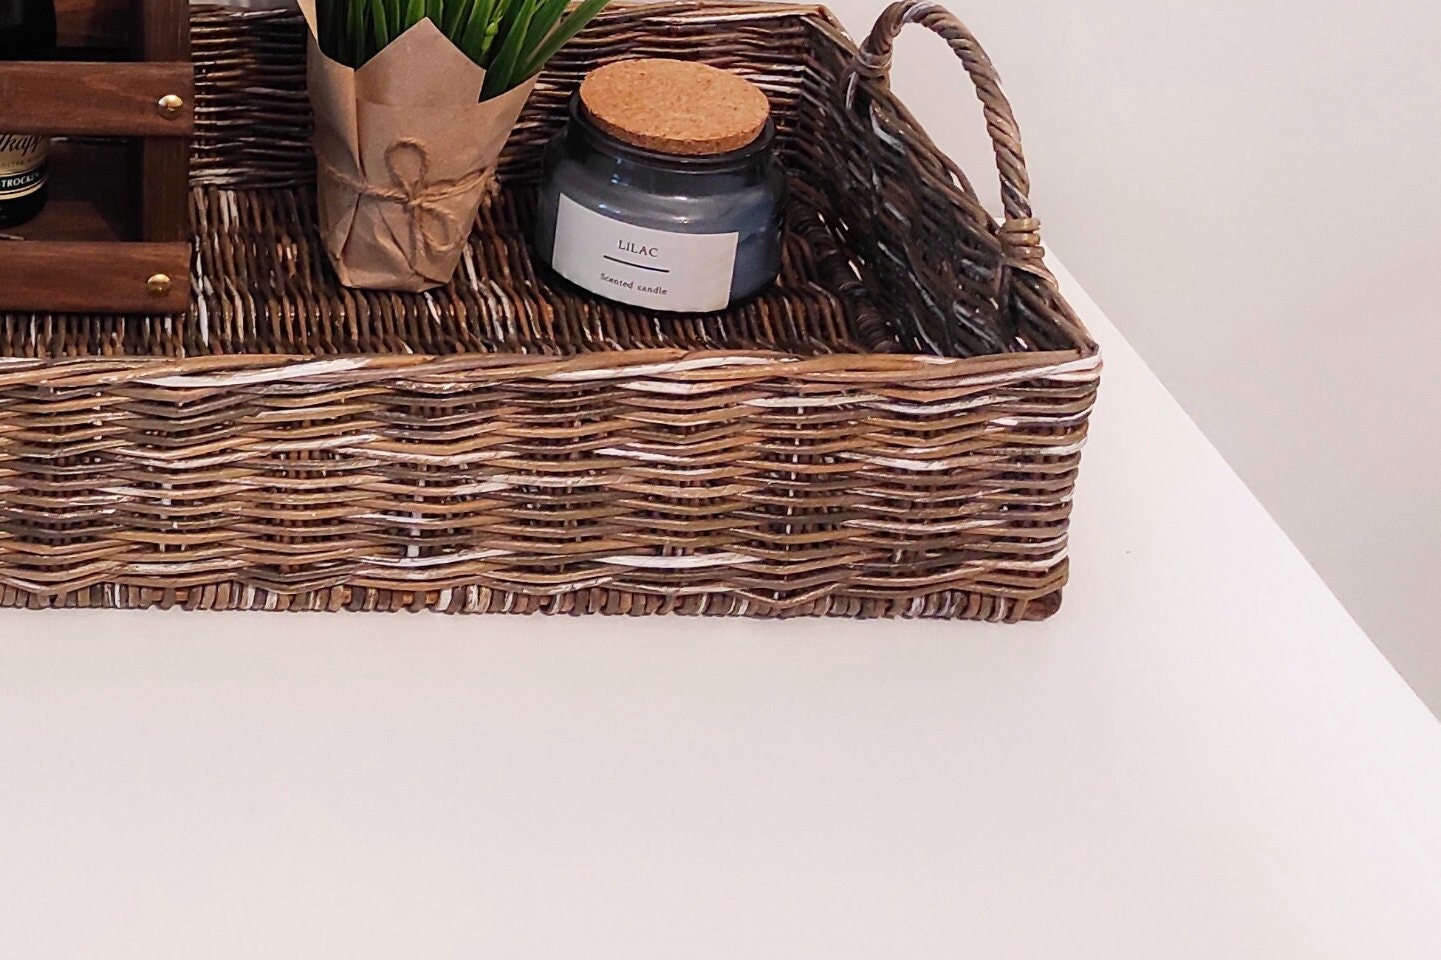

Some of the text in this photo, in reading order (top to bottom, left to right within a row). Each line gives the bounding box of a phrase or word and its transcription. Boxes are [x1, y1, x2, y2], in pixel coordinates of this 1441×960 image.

[618, 240, 658, 257] LILAC
[600, 272, 668, 295] Scented candle
